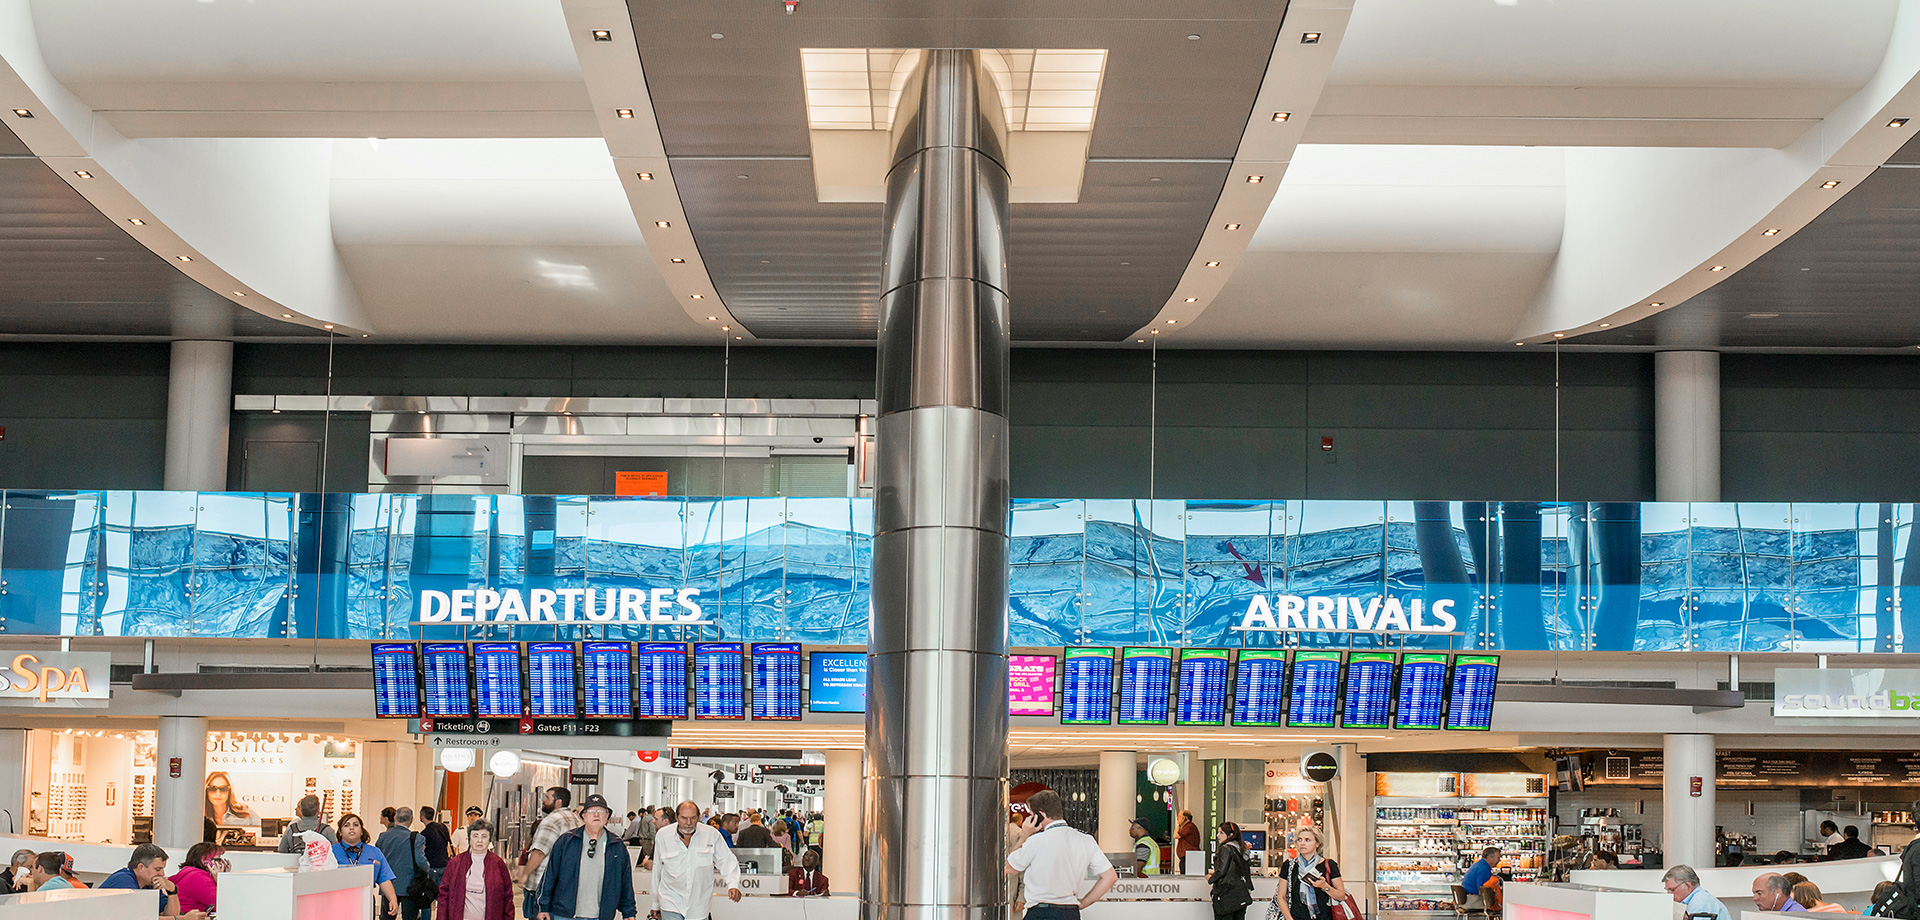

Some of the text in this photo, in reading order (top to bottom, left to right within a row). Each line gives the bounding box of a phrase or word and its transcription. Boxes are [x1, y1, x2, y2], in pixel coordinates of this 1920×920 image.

[420, 588, 702, 622] DEPARTURES
[1241, 594, 1457, 632] ARRIVALS
[437, 722, 474, 732] Ticketing
[537, 724, 560, 732] Gates
[585, 724, 600, 732] F23
